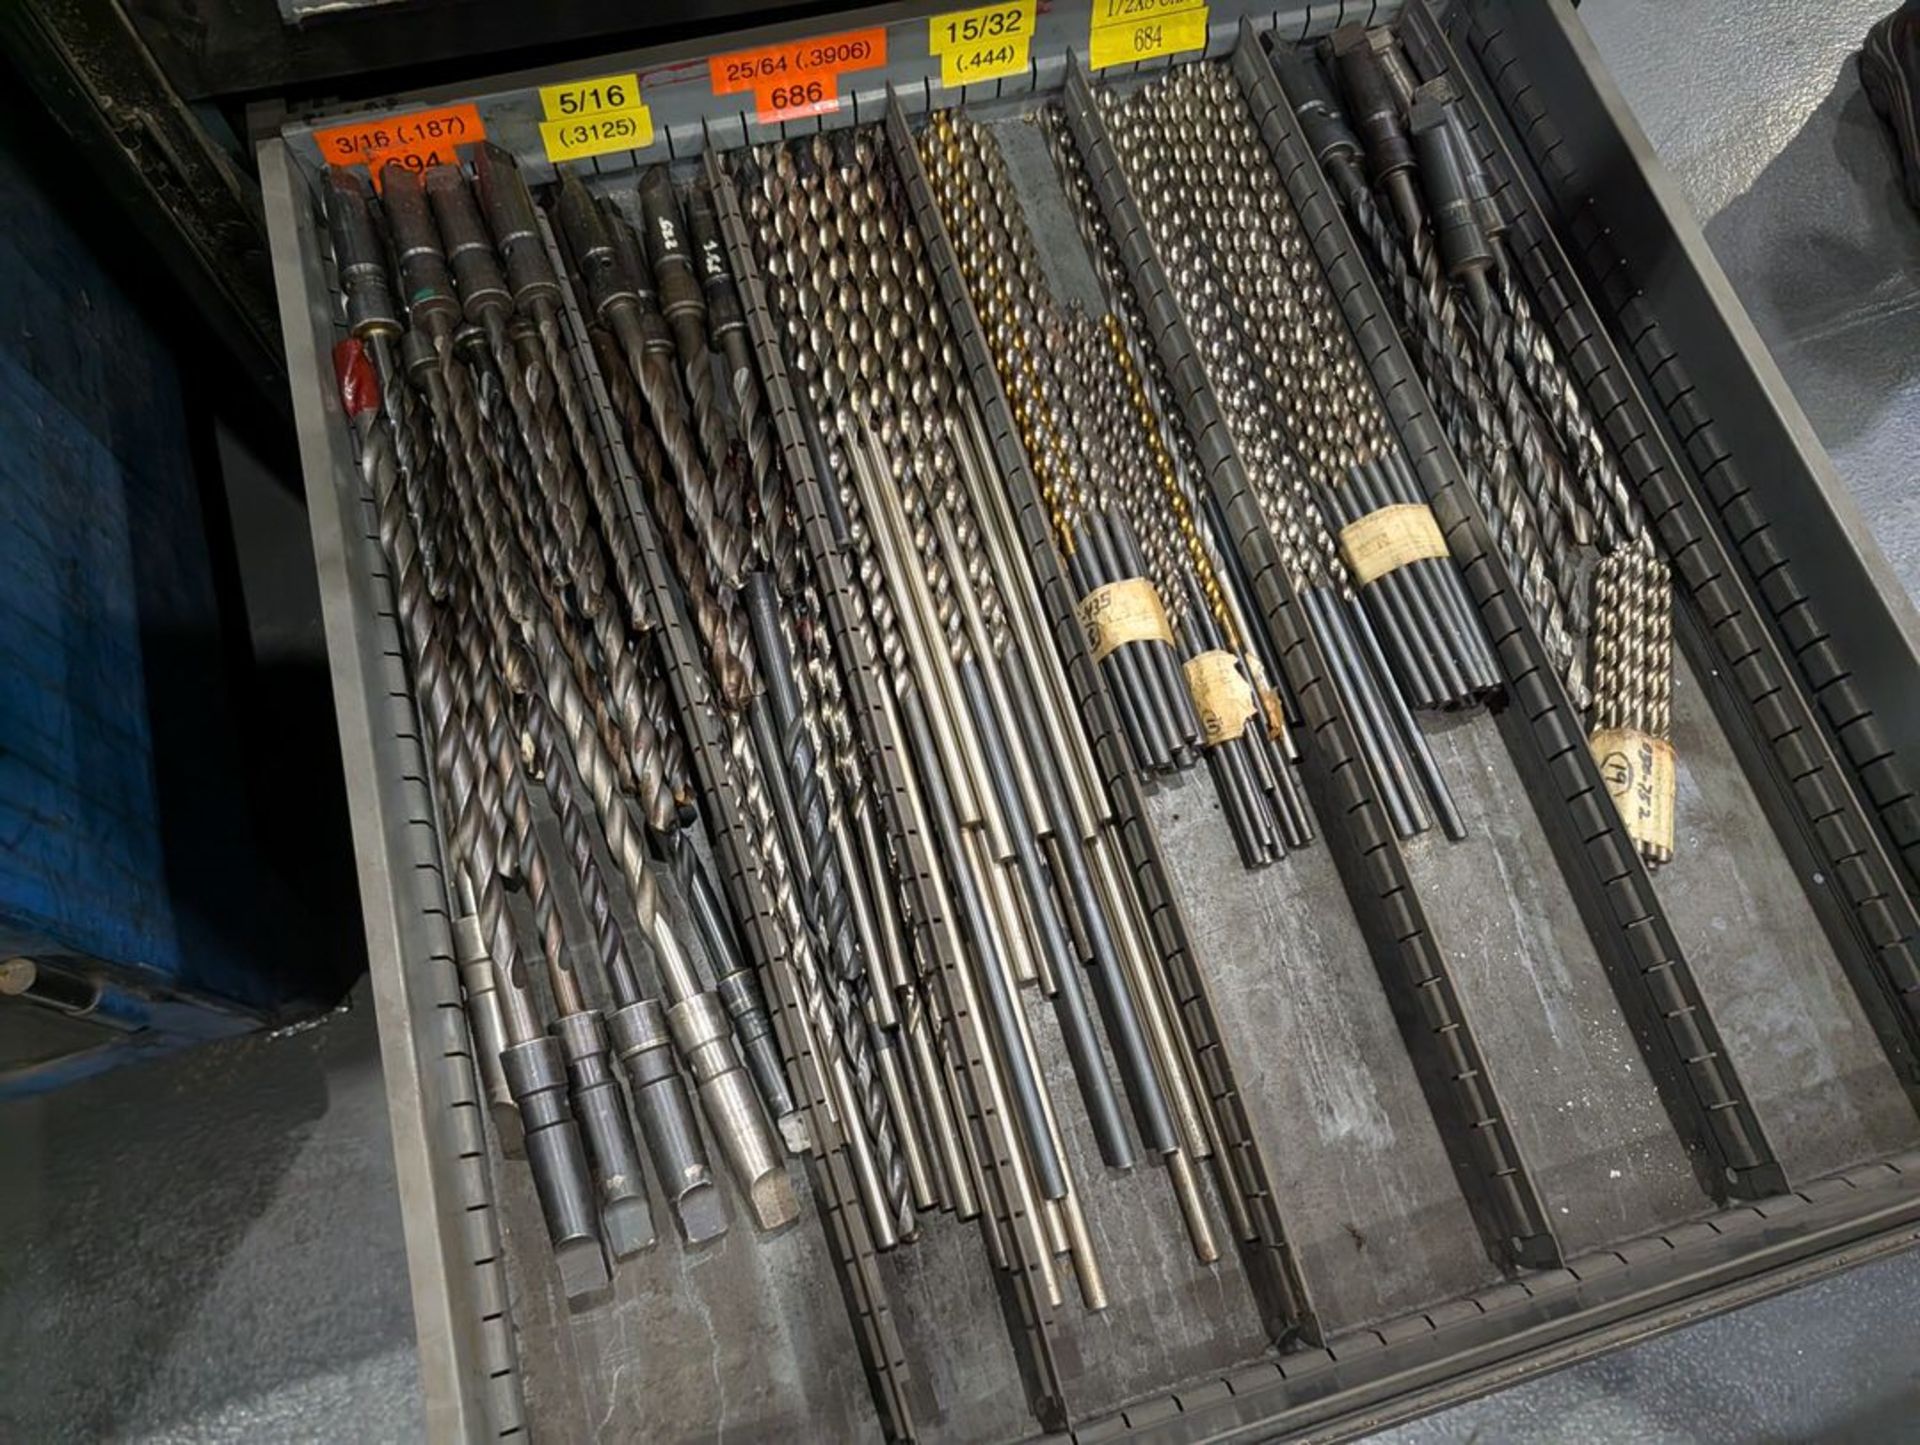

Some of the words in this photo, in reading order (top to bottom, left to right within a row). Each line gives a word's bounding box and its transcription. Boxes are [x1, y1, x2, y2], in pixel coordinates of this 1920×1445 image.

[946, 9, 1022, 43] 15/32
[1134, 25, 1162, 52] 684
[726, 56, 788, 82] 25/64
[795, 40, 872, 70] (.3906)
[956, 45, 1015, 73] (.444)
[560, 84, 625, 115] 5/16
[770, 81, 823, 110] 686
[335, 130, 390, 154] 3/16
[397, 116, 465, 144] (.187)
[558, 117, 637, 148] (.3125)
[1605, 763, 1627, 785] 19
